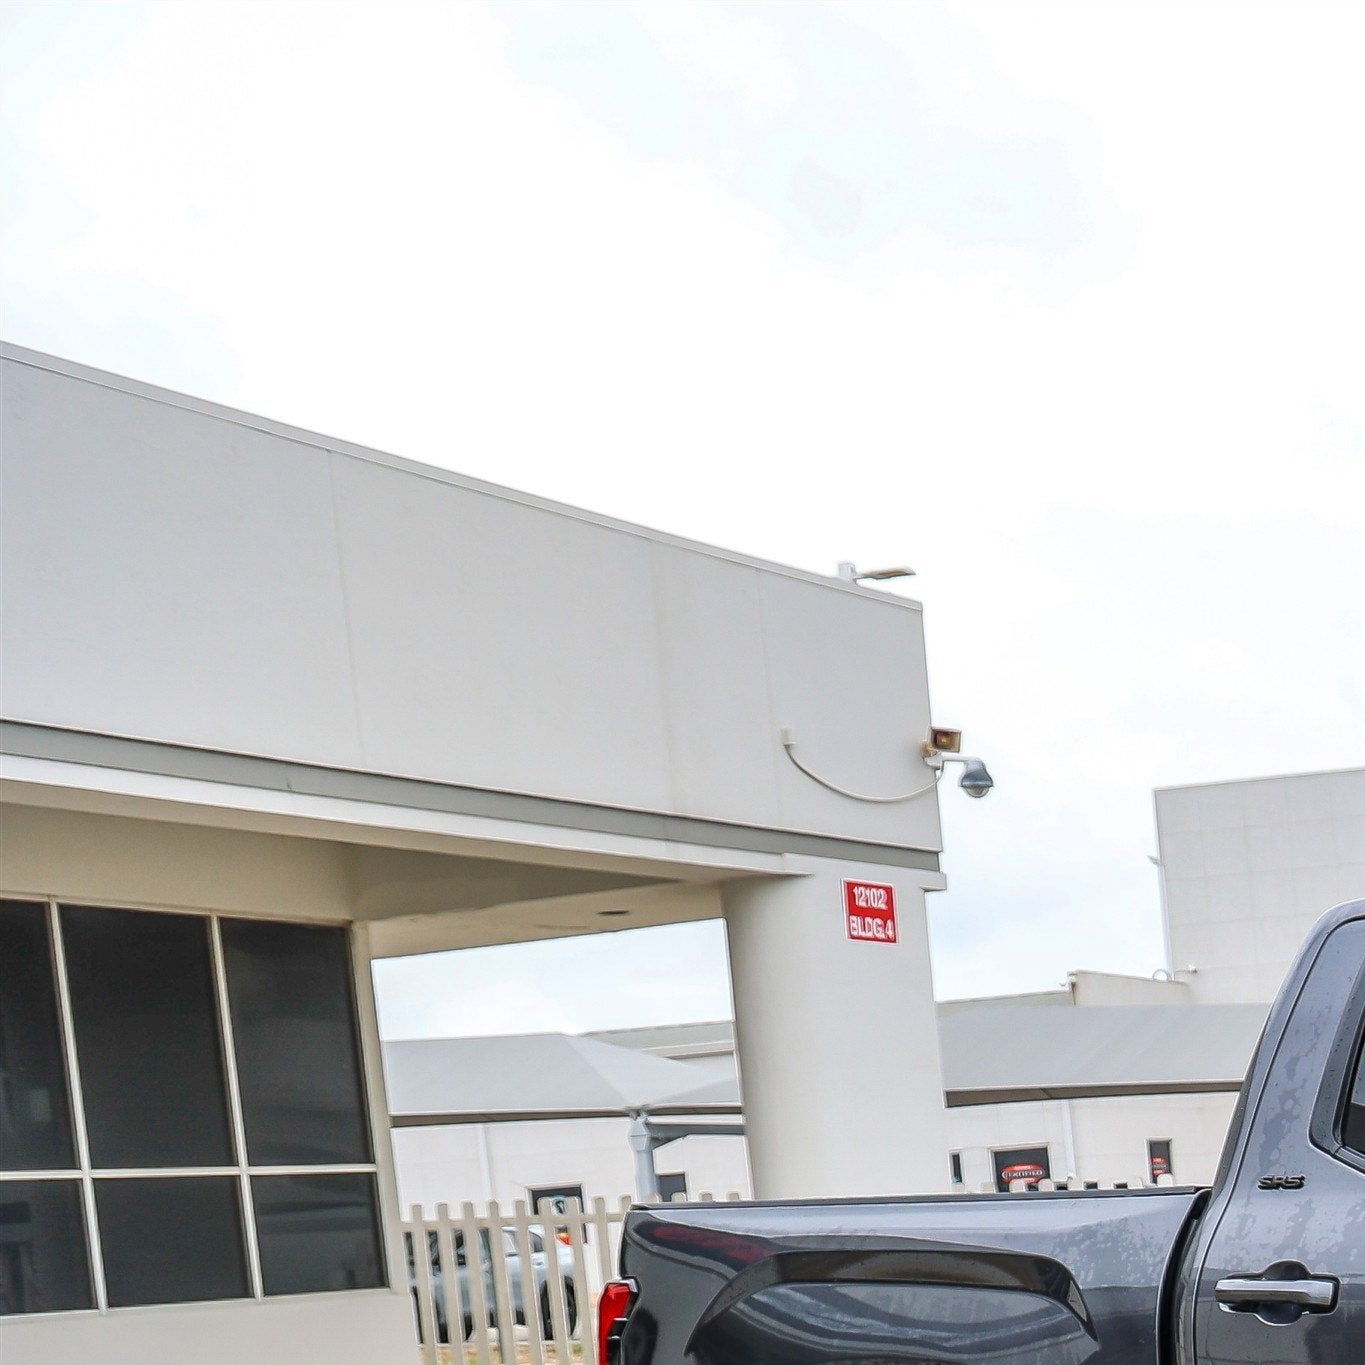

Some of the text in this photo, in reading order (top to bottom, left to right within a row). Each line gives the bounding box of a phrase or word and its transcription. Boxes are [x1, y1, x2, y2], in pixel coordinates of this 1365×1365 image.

[853, 886, 888, 910] 12102
[885, 919, 895, 939] 4
[1257, 1174, 1306, 1190] SR5
